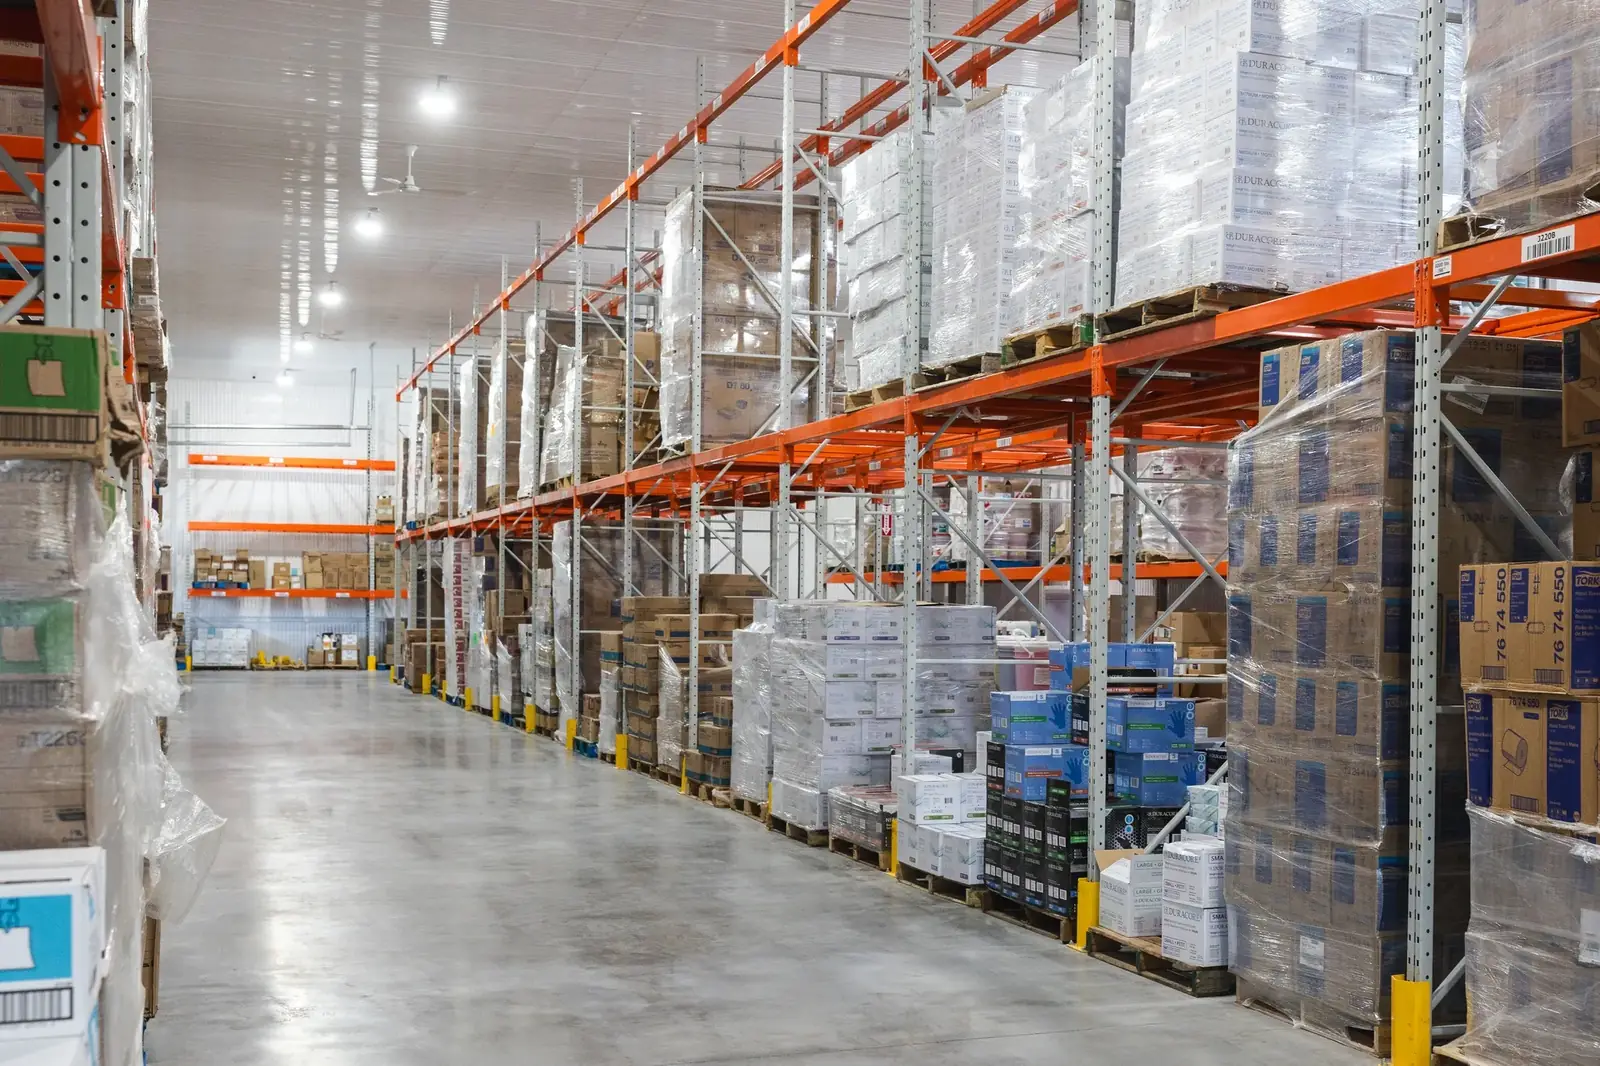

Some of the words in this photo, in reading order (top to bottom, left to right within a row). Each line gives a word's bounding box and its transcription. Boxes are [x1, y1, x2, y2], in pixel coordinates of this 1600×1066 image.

[1496, 568, 1507, 604] 550
[1553, 566, 1565, 603] 550
[1496, 609, 1507, 632] 74
[1553, 609, 1565, 634] 74
[1496, 638, 1507, 661] 76
[1553, 640, 1565, 664] 76
[1550, 707, 1568, 719] TORK
